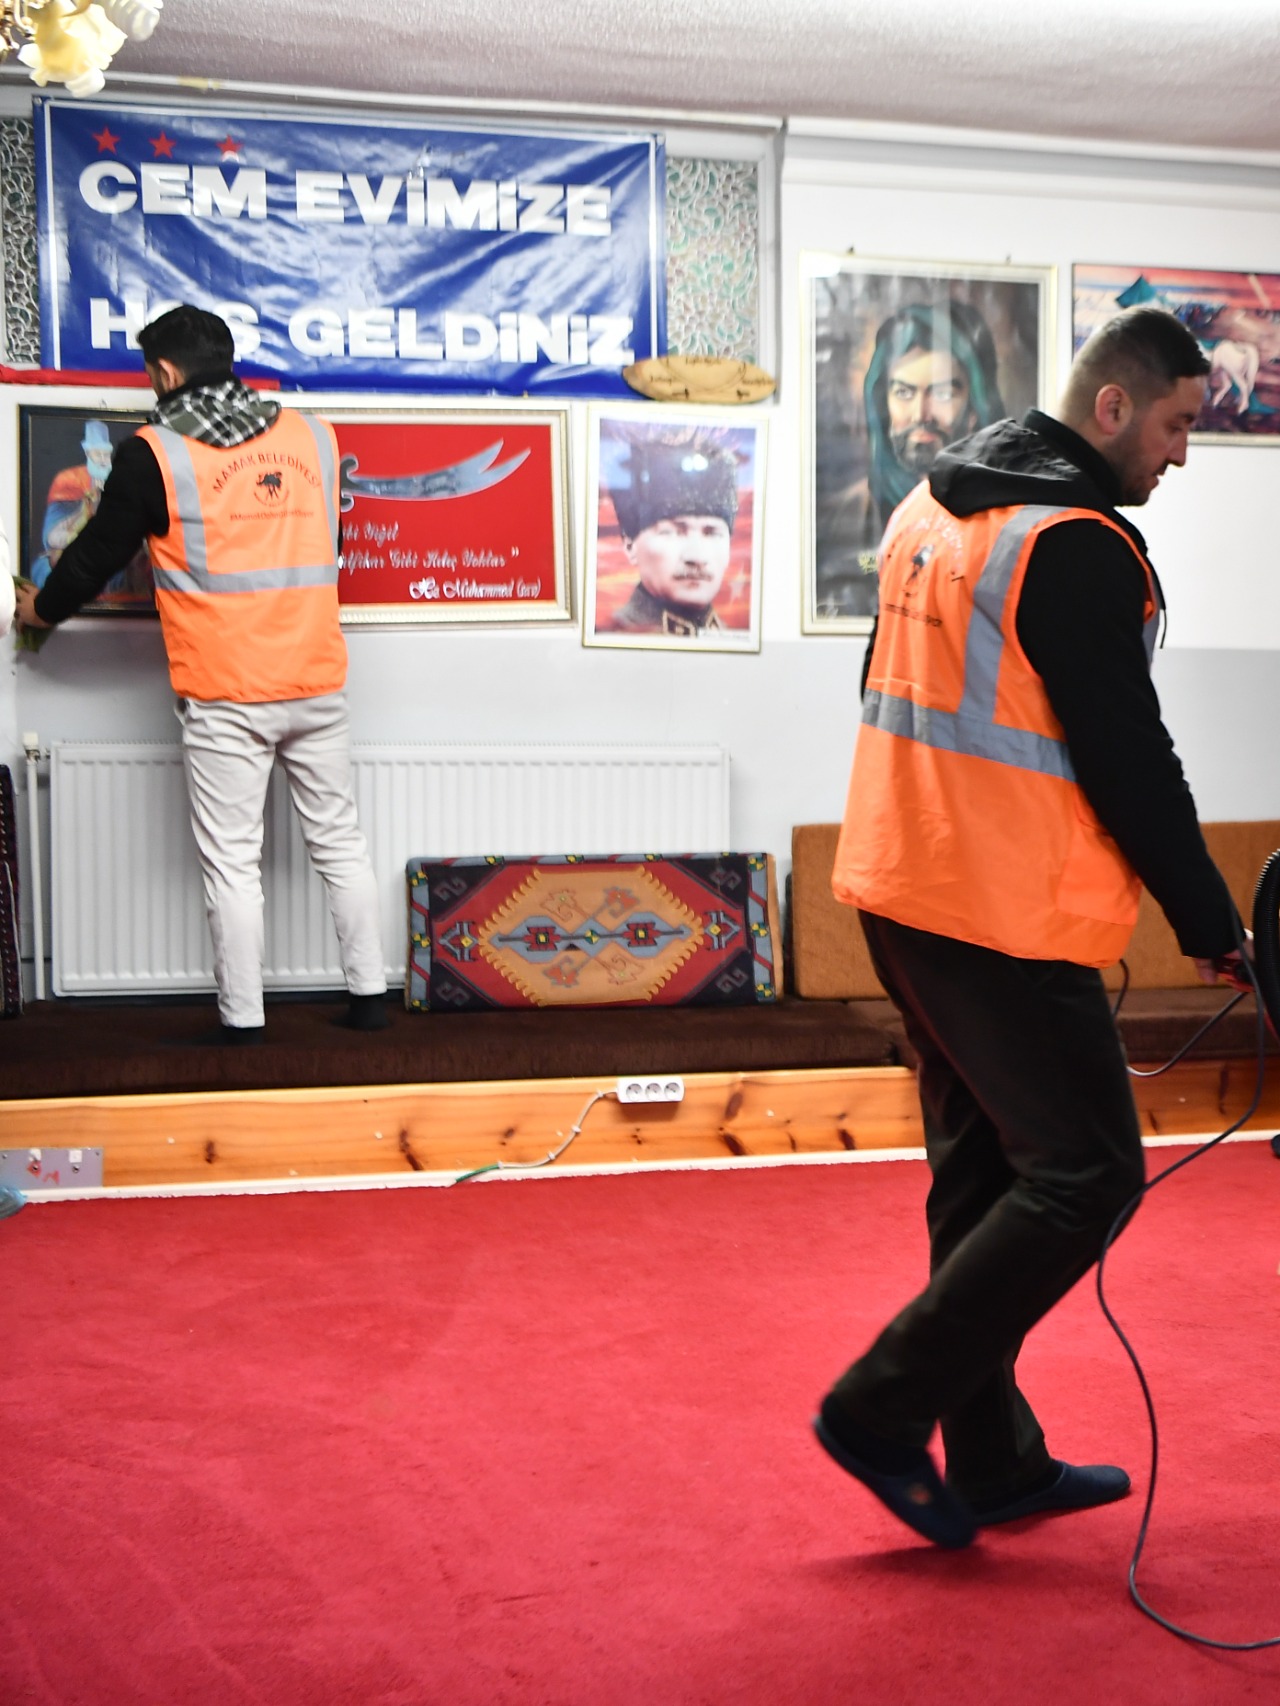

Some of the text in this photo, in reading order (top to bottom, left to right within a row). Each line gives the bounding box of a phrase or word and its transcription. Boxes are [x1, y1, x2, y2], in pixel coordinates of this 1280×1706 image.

[79, 160, 267, 219] CEM
[212, 455, 256, 494] MAMAK
[442, 577, 514, 599] Muhammed
